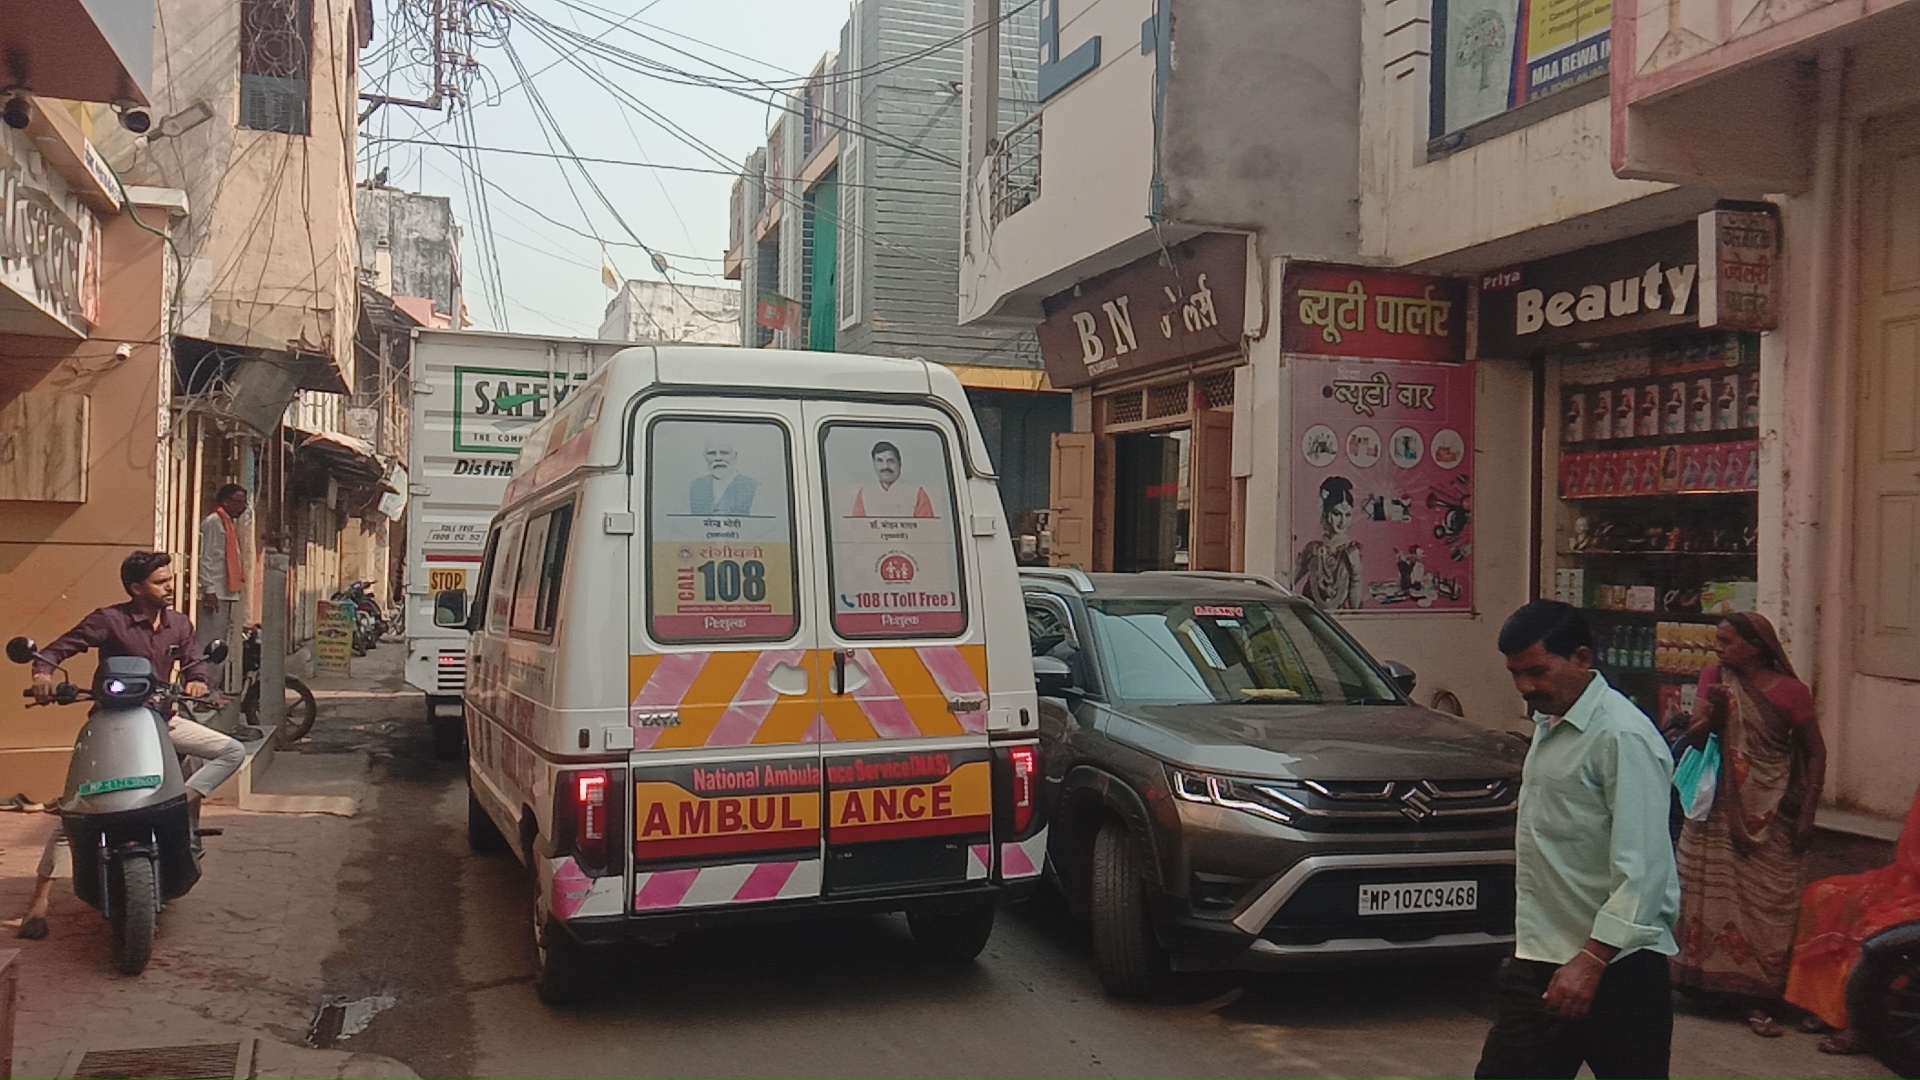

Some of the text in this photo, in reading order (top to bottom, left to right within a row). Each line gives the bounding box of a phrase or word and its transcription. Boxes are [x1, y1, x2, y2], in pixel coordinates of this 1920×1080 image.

[1532, 60, 1559, 87] MAA
[1562, 44, 1598, 79] REWA
[1483, 269, 1521, 290] Priya
[1298, 279, 1451, 344] ब्यूटी पार्लर
[1516, 262, 1697, 335] Beauty
[475, 381, 579, 417] SAFEX
[473, 433, 490, 442] THE
[431, 572, 462, 590] STOP
[678, 566, 694, 601] CALL
[698, 560, 766, 602] 108
[856, 592, 880, 608] 108
[639, 711, 681, 728] TATA
[693, 765, 759, 791] National
[1370, 886, 1475, 911] MP10ZC9468
